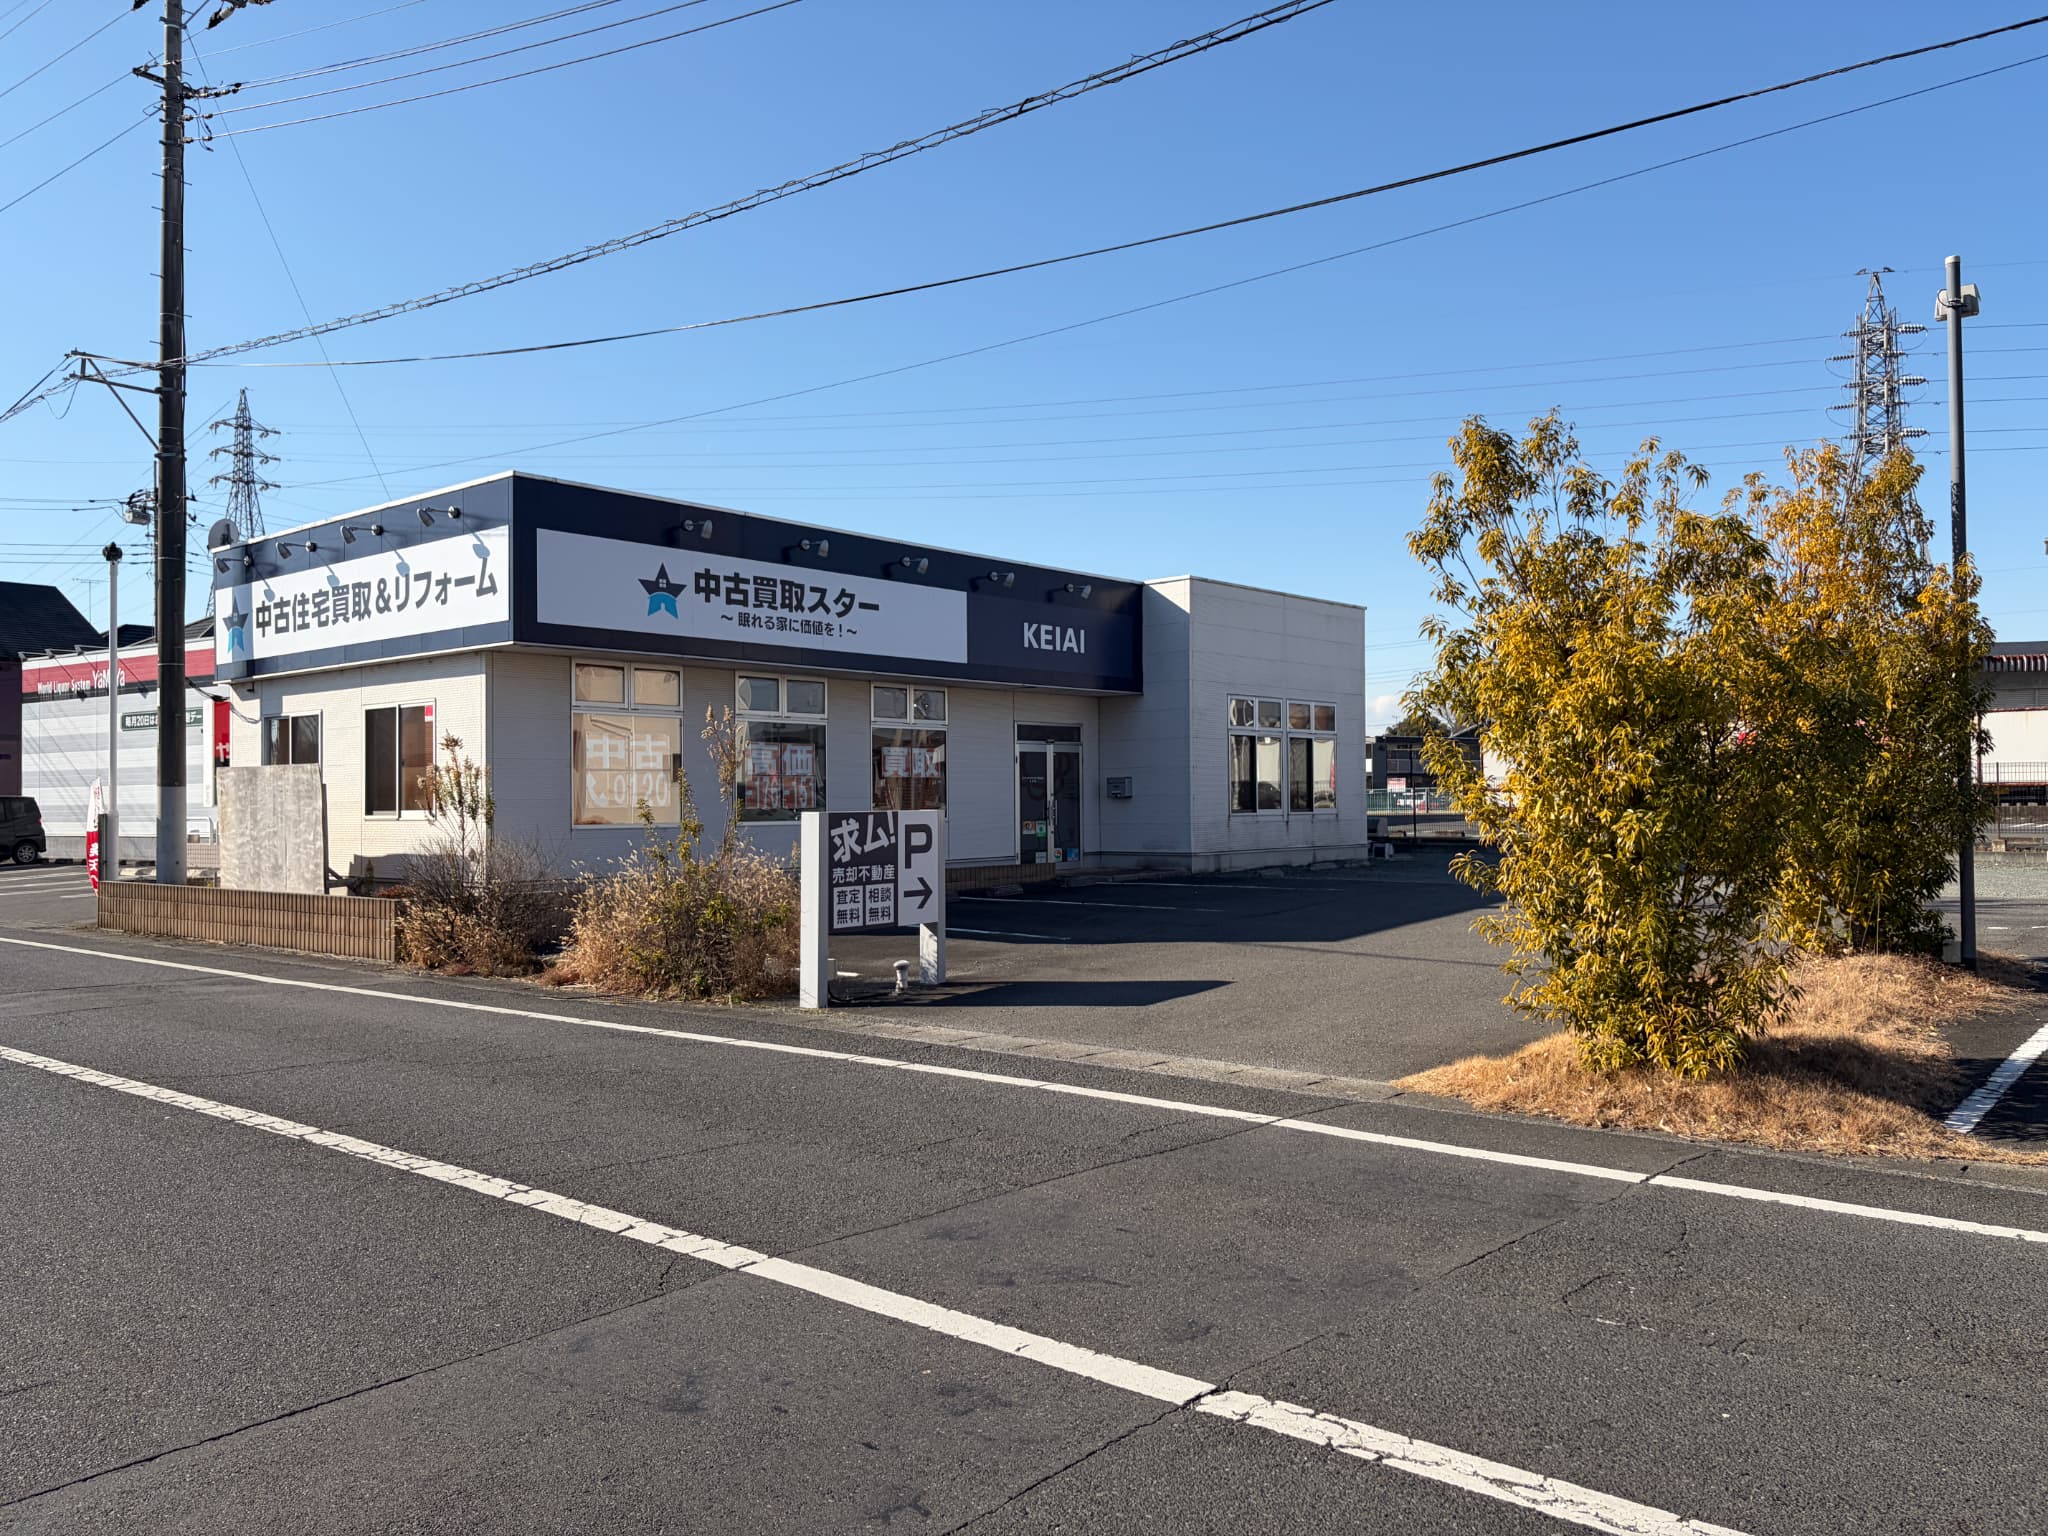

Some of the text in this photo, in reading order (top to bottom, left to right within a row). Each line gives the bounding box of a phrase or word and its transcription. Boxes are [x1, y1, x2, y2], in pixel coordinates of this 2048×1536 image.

[255, 557, 498, 638] 中古住宅買取&リフォーム
[694, 568, 880, 618] 中古買取スター
[1023, 622, 1085, 654] KEIAI
[586, 733, 667, 769] 中古
[746, 742, 814, 776] 高価
[881, 746, 939, 778] 買取
[613, 771, 669, 807] 0120
[830, 812, 897, 863] 求ム!
[904, 823, 933, 870] P
[832, 864, 896, 884] 売却不動産
[836, 886, 861, 905] 査定
[868, 886, 892, 904] 相談
[836, 907, 860, 925] 無料
[868, 905, 891, 923] 無料
